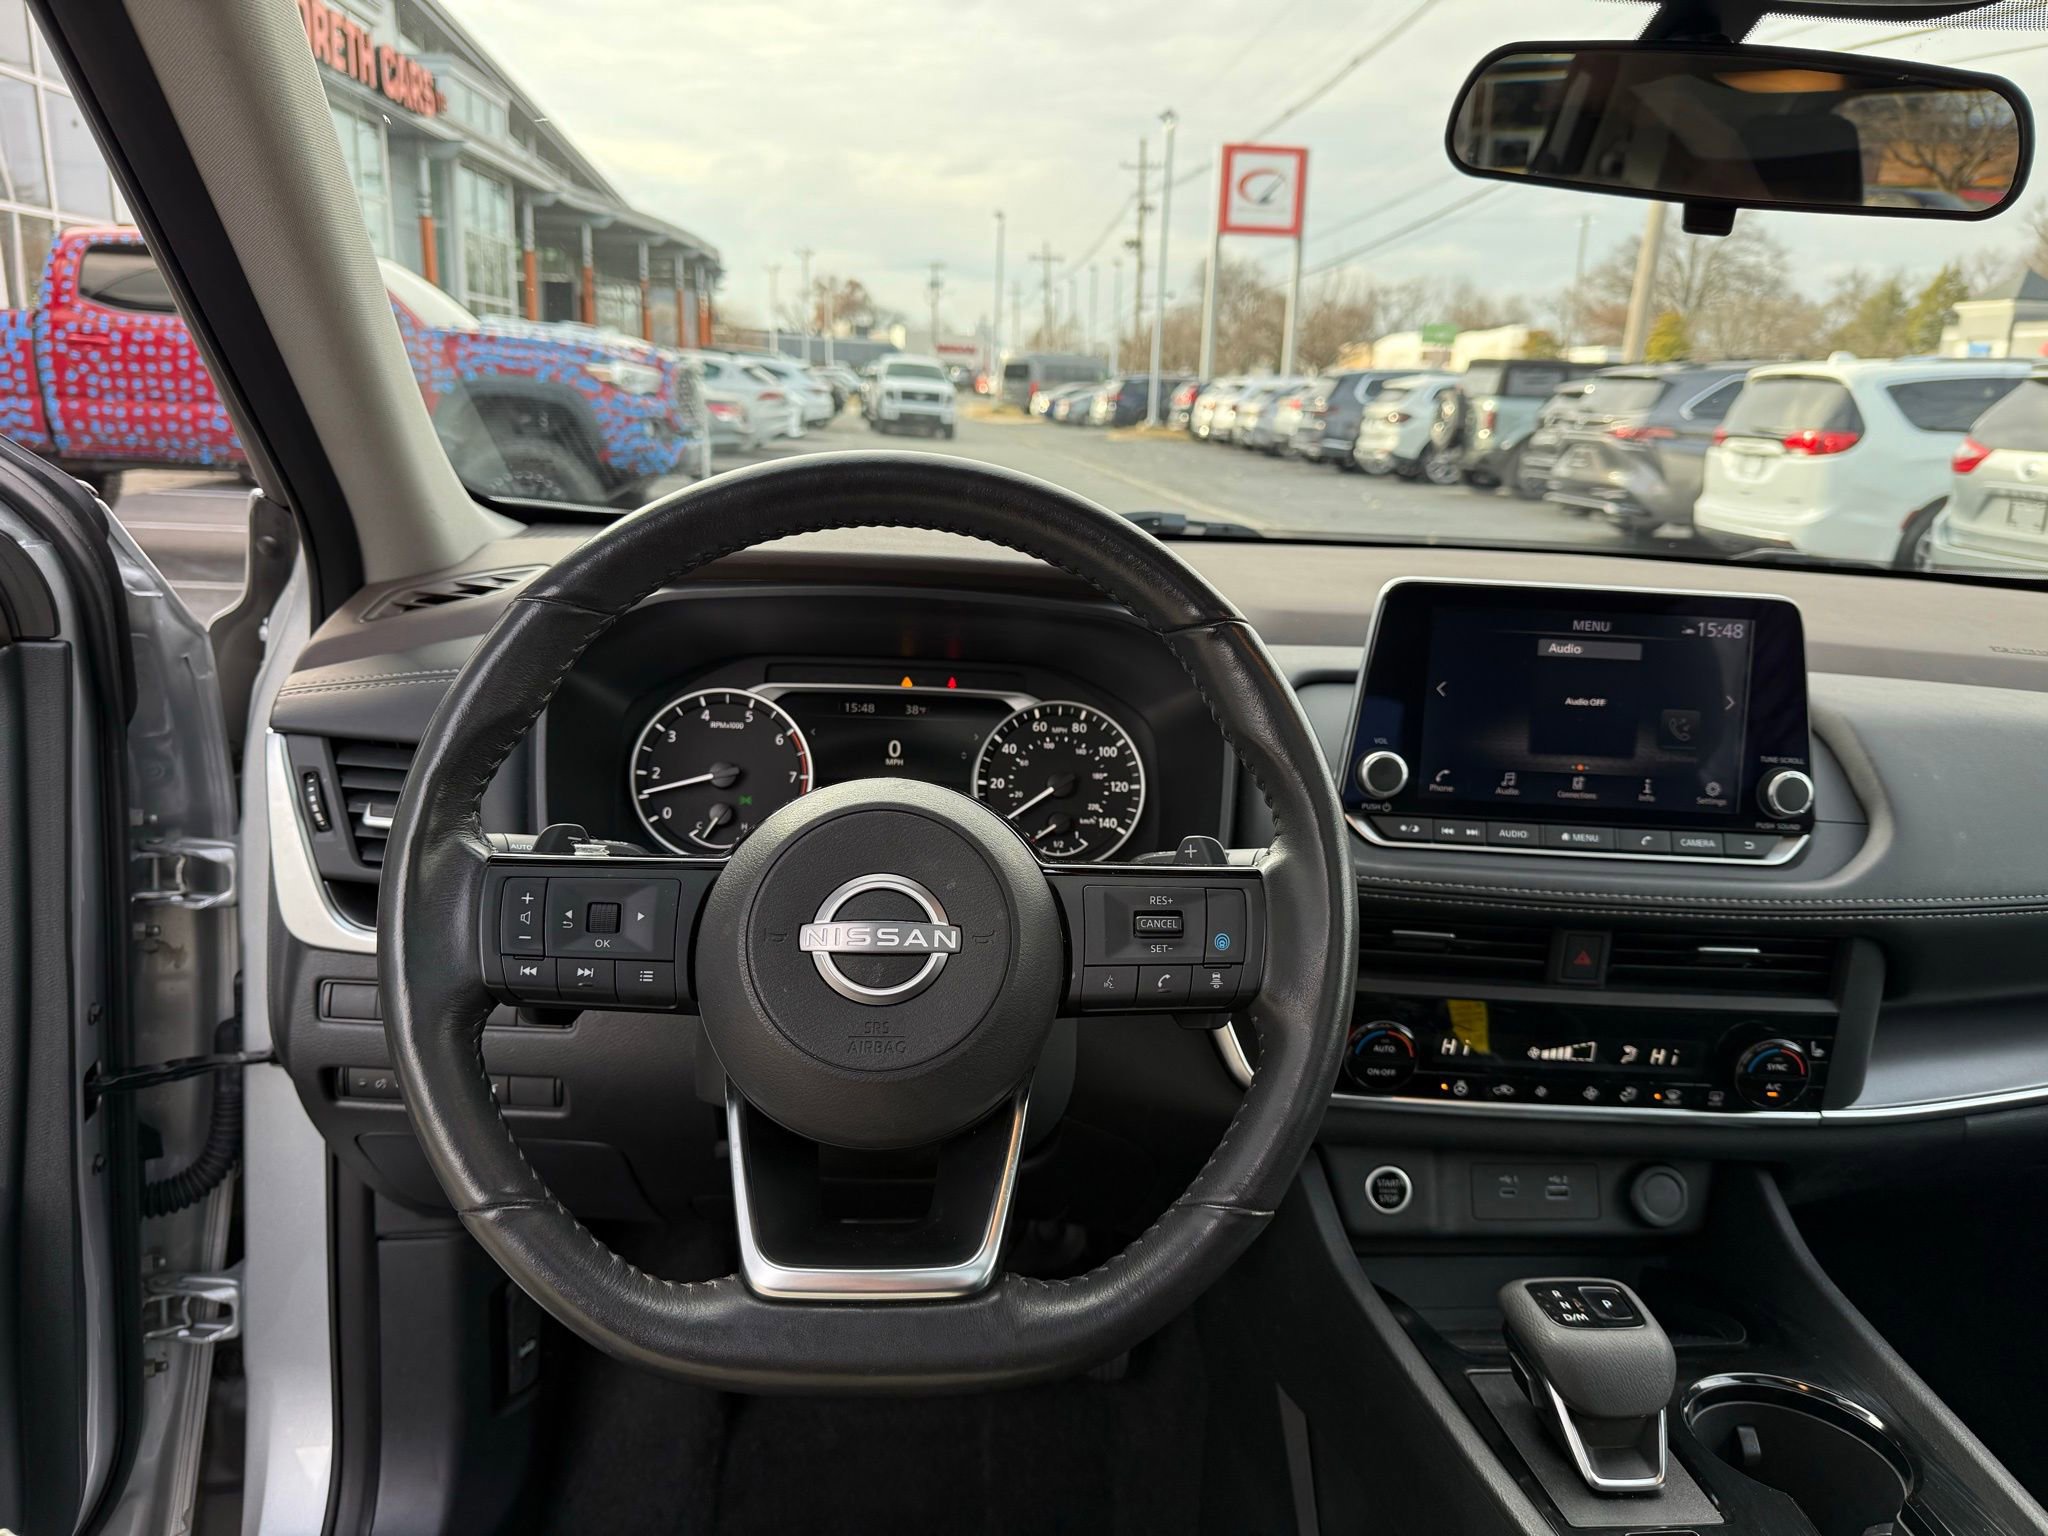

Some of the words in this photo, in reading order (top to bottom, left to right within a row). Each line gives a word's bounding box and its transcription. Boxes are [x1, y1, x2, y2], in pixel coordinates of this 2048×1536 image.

[379, 43, 437, 117] CARS
[1572, 619, 1611, 632] MENU
[1697, 621, 1744, 639] 15:48
[1549, 643, 1583, 655] Audio
[1565, 697, 1589, 707] Audio
[845, 703, 875, 713] 15:48
[700, 709, 710, 721] 4
[745, 711, 754, 723] 5
[1032, 721, 1048, 733] 60
[1052, 726, 1068, 735] MPH
[1071, 722, 1087, 734] 80
[667, 731, 677, 743] 3
[775, 735, 784, 746] 6
[1373, 736, 1388, 745] VOL
[888, 740, 901, 757] 0
[1001, 743, 1017, 755] 40
[1098, 746, 1118, 758] 100
[885, 758, 904, 766] MPH
[651, 767, 661, 779] 2
[789, 771, 798, 784] 7
[990, 778, 1005, 790] 20
[1110, 781, 1129, 793] 120
[1429, 783, 1454, 793] Phone
[1496, 786, 1520, 796] Audio
[1361, 802, 1381, 811] PUSH
[662, 807, 672, 819] 0
[1098, 817, 1118, 829] 140
[1499, 829, 1529, 840] AUDIO
[1572, 833, 1600, 844] MENU
[510, 843, 534, 852] AUTO
[1680, 838, 1716, 849] CAMERA
[1149, 895, 1174, 906] RES+
[1140, 919, 1178, 929] CANCEL
[804, 926, 957, 949] NISSAN
[595, 938, 611, 949] OK
[864, 1021, 889, 1034] SRS
[847, 1040, 906, 1054] AIRBAG
[1373, 1044, 1396, 1053] AUTO
[1766, 1062, 1789, 1072] SYNC
[1551, 1289, 1563, 1298] R
[1559, 1301, 1572, 1310] N
[1601, 1299, 1612, 1309] P
[1562, 1313, 1590, 1322] D/M
